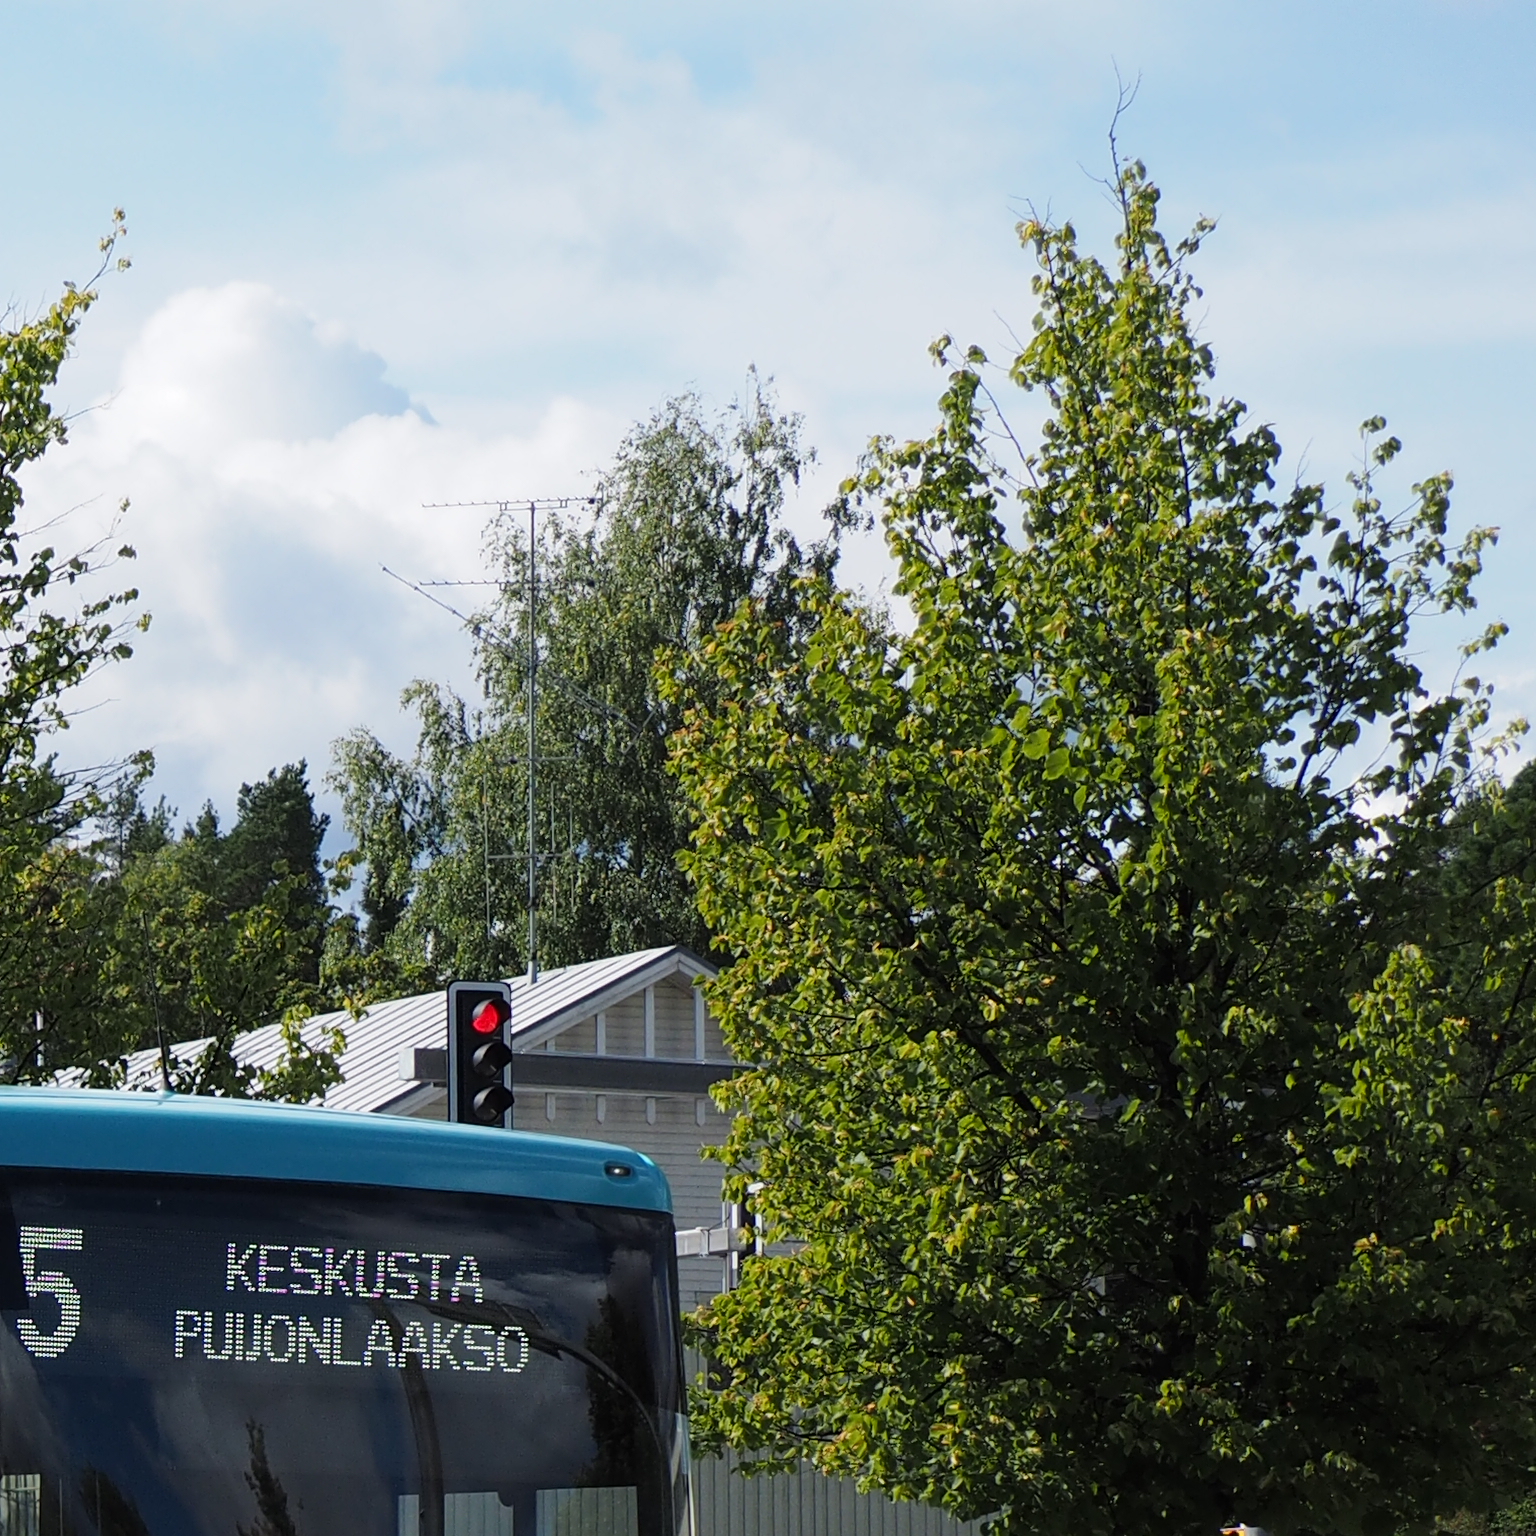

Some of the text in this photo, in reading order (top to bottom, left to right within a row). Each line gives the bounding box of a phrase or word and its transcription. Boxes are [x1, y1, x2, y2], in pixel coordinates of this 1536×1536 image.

[16, 1225, 83, 1358] 5
[225, 1241, 484, 1304] KESKUSTA
[174, 1308, 530, 1373] PUIJONLAAKSO
